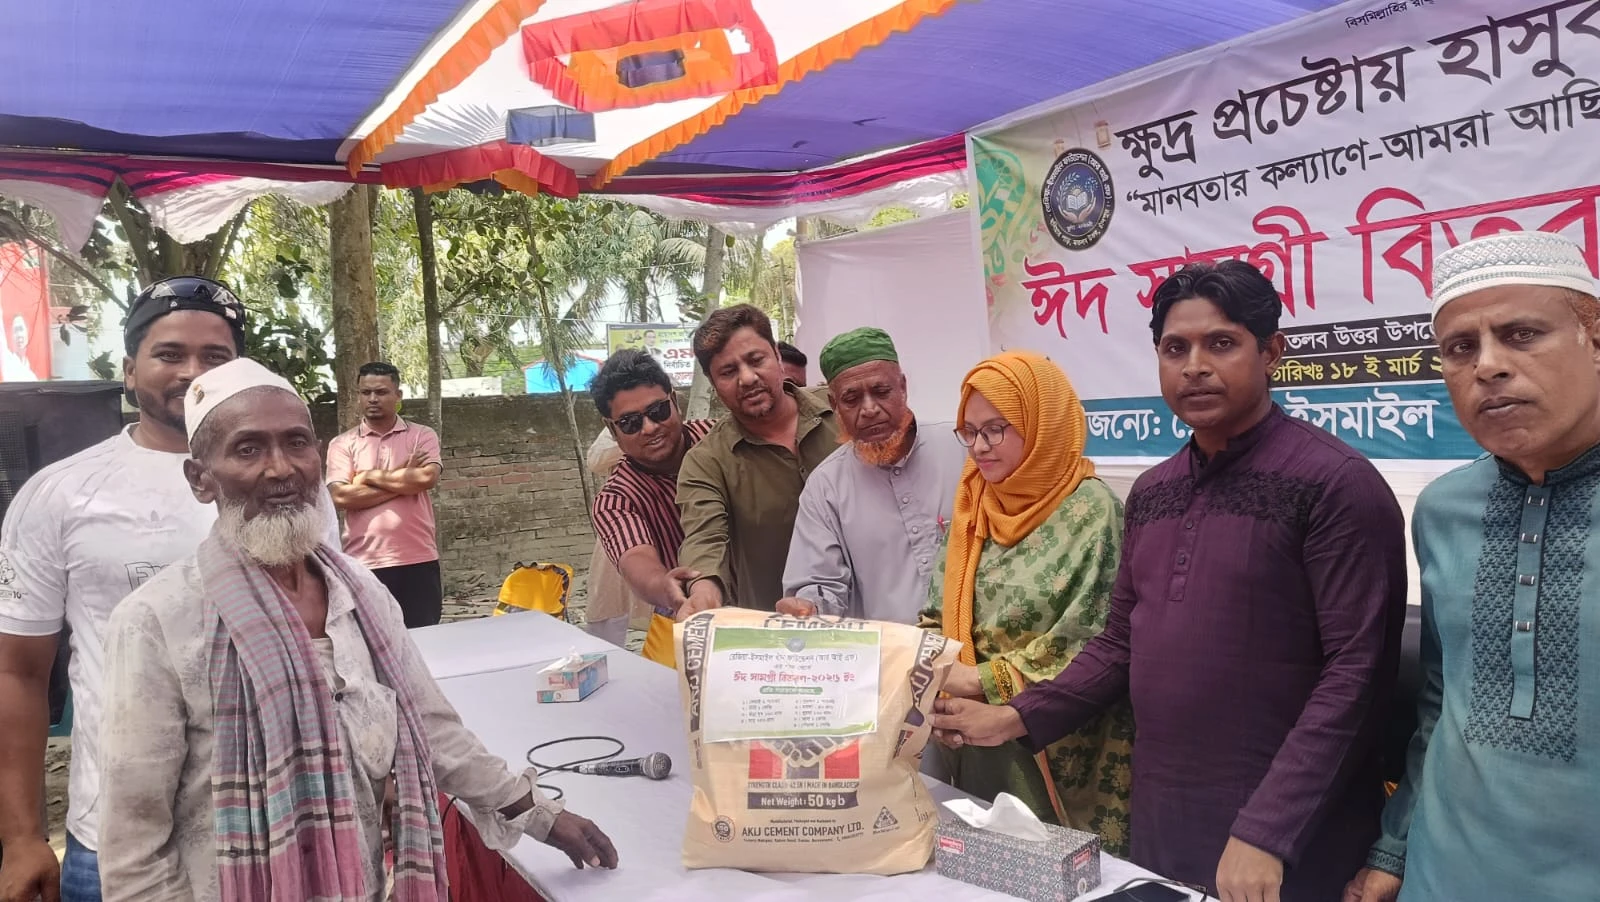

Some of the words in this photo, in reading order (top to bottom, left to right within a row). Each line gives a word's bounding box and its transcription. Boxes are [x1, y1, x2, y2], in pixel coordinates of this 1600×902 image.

[1114, 110, 1198, 180] ক্ষুদ্র
[1213, 46, 1416, 144] প্রচেষ্টায়
[1021, 256, 1118, 339] ঈদ
[1284, 330, 1329, 352] তলব
[1333, 325, 1380, 346] উত্তর
[1330, 362, 1358, 380] ১৮
[1363, 354, 1382, 379] ই
[1385, 350, 1424, 376] মার্চ
[1084, 408, 1161, 441] জন্যে:
[761, 797, 775, 806] Net
[808, 794, 824, 808] 50
[826, 797, 836, 808] kg
[742, 826, 762, 837] AKIJ
[764, 826, 800, 837] CEMENT
[802, 824, 845, 837] COMPANY
[847, 821, 865, 834] LTD.
